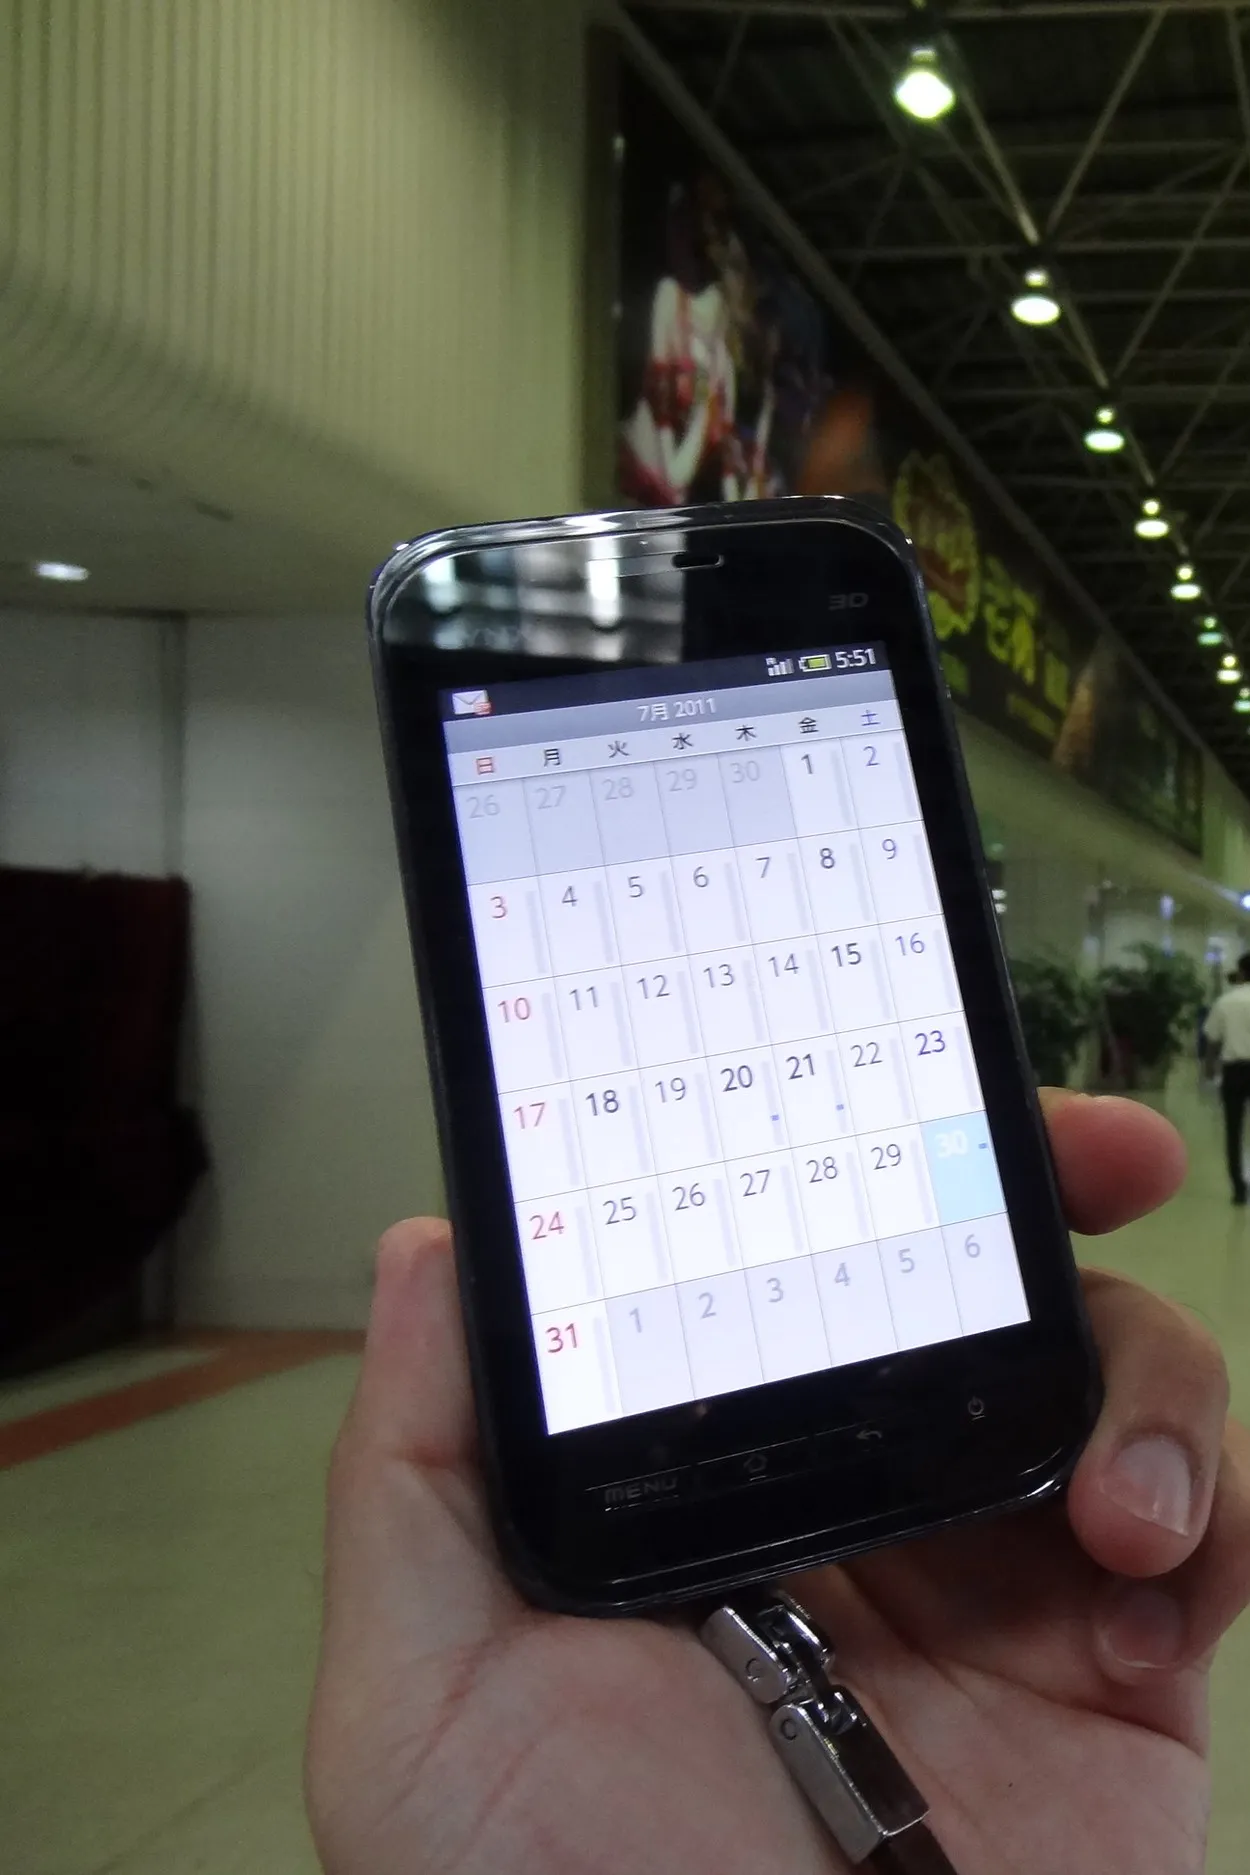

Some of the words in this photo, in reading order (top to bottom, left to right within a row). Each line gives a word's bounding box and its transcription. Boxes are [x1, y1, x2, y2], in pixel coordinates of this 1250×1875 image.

[834, 648, 876, 669] 5:51
[475, 755, 496, 776] 日
[543, 747, 562, 767] 月
[607, 740, 630, 759] 火
[672, 732, 694, 751] 水
[735, 724, 757, 742] 木
[798, 716, 819, 735] 金
[860, 709, 880, 727] 土
[637, 702, 669, 721] 7月
[673, 698, 717, 718] 2011
[466, 794, 499, 819] 26
[535, 785, 566, 810] 27
[602, 777, 634, 800] 28
[666, 769, 697, 792] 29
[730, 760, 760, 783] 30
[801, 754, 813, 774] 1
[863, 745, 879, 767] 2
[490, 895, 508, 920] 3
[561, 885, 578, 907] 4
[627, 875, 645, 899] 5
[692, 865, 710, 889] 6
[755, 855, 772, 879] 7
[819, 847, 836, 870] 8
[881, 837, 898, 861] 9
[497, 996, 532, 1024] 10
[569, 985, 599, 1011] 11
[636, 973, 671, 1000] 12
[702, 963, 736, 989] 13
[767, 952, 800, 978] 14
[830, 942, 862, 968] 15
[894, 931, 926, 957] 16
[513, 1101, 546, 1130] 17
[585, 1088, 620, 1117] 18
[654, 1076, 687, 1104] 19
[720, 1064, 754, 1093] 20
[785, 1053, 815, 1081] 21
[850, 1041, 883, 1068] 22
[914, 1029, 946, 1057] 23
[529, 1210, 565, 1241] 24
[602, 1196, 637, 1226] 25
[672, 1182, 706, 1212] 26
[739, 1168, 771, 1198] 27
[806, 1155, 839, 1184] 28
[870, 1143, 902, 1171] 29
[935, 1129, 968, 1158] 30
[546, 1323, 578, 1354] 31
[628, 1307, 643, 1334] 1
[698, 1291, 717, 1320] 2
[766, 1277, 785, 1304] 3
[833, 1262, 851, 1287] 4
[898, 1247, 916, 1274] 5
[964, 1233, 981, 1259] 6
[604, 1477, 679, 1504] MENU
